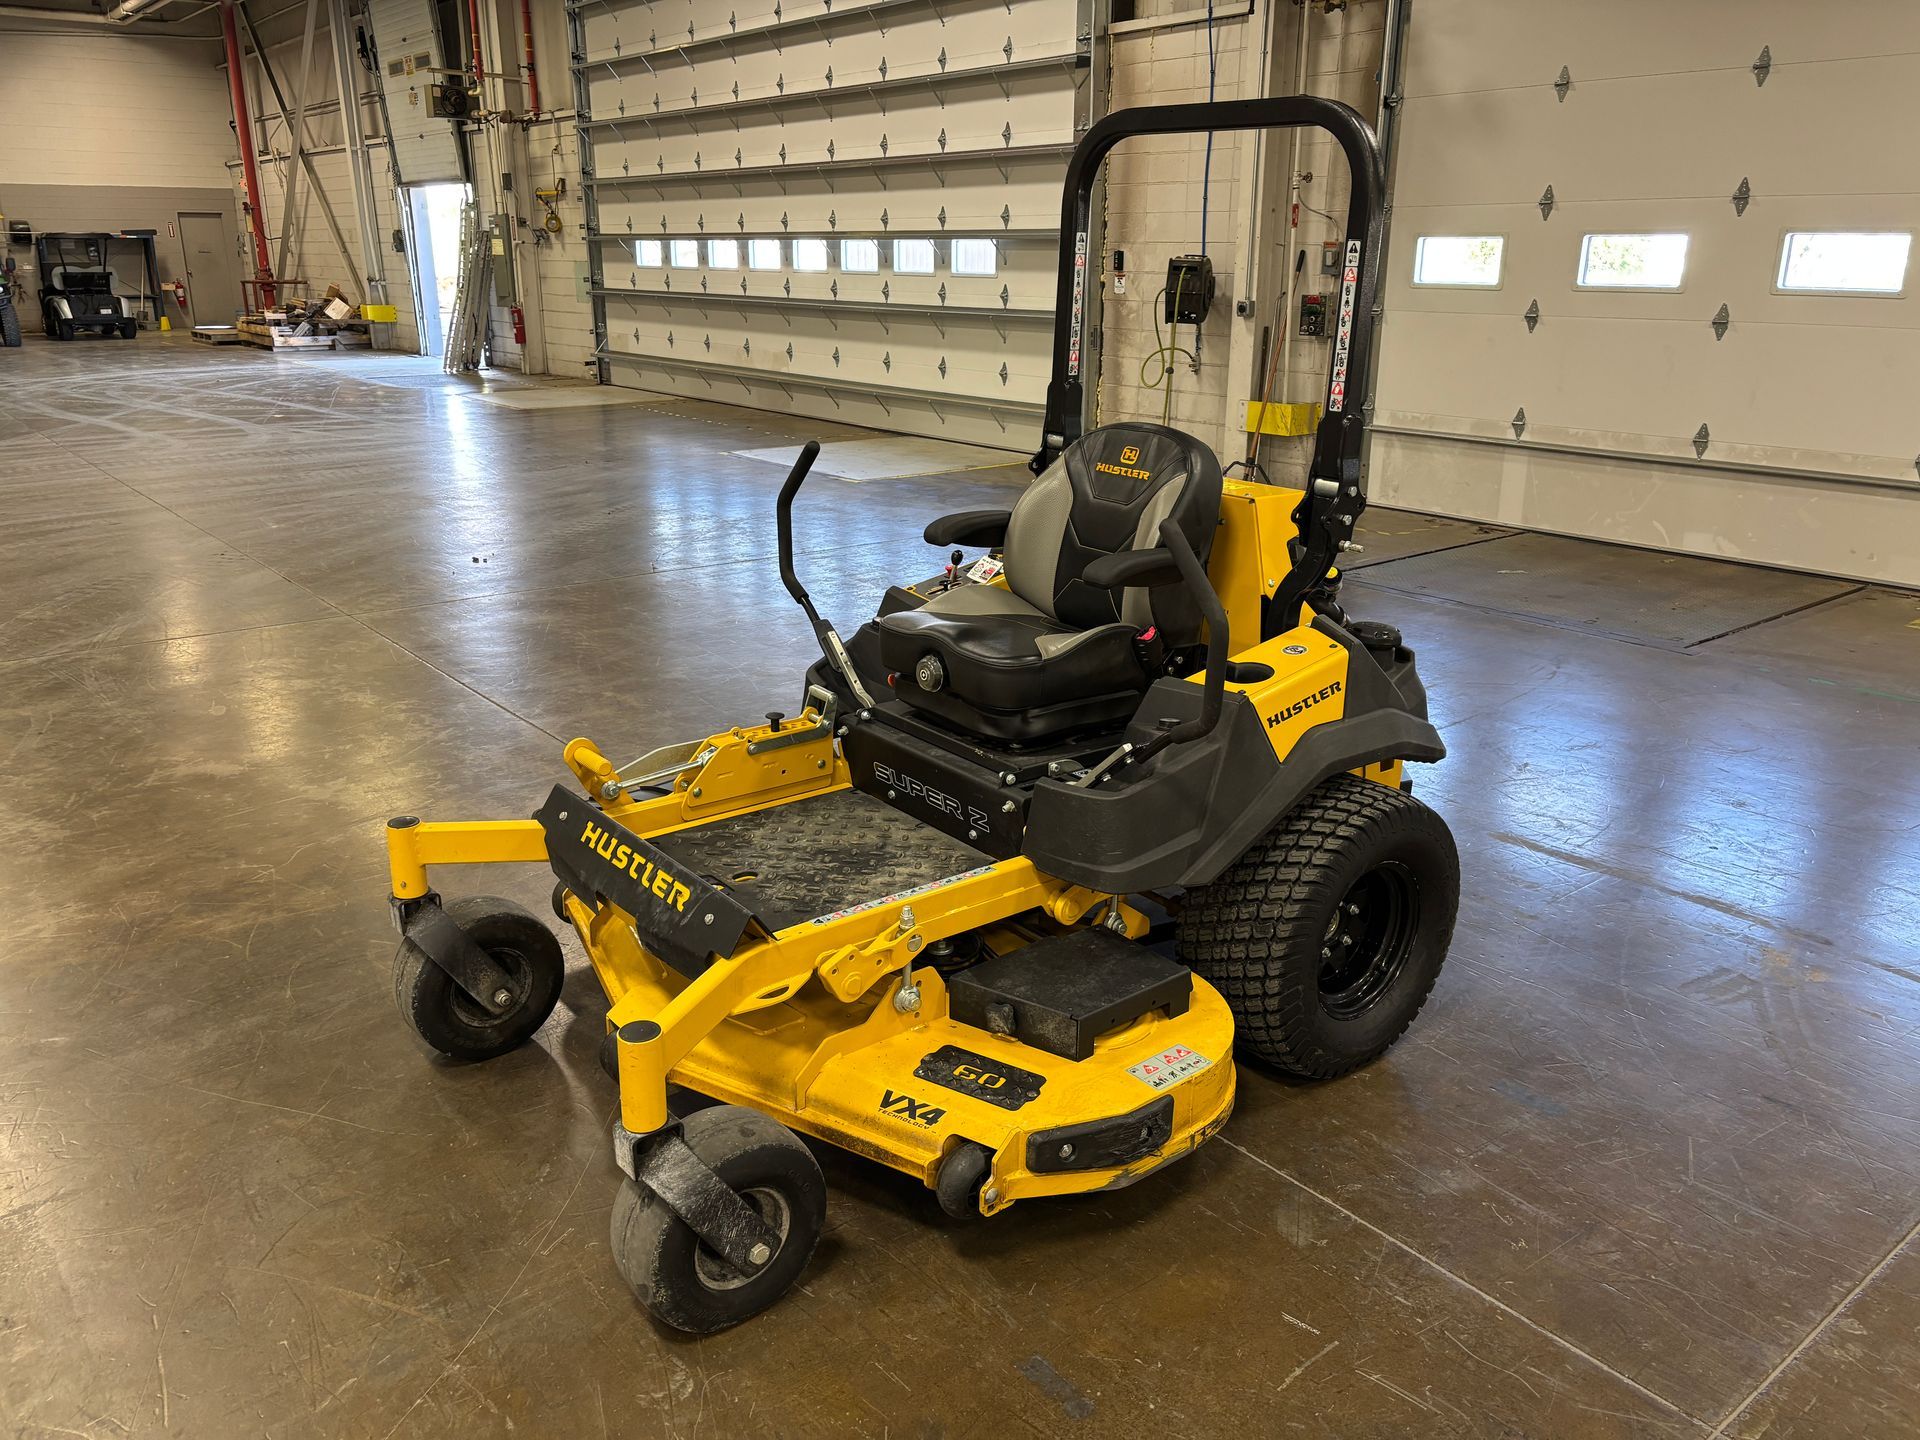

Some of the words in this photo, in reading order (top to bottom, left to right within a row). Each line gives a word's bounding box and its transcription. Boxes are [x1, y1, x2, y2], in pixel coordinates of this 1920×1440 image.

[1096, 462, 1150, 481] HUSTLER
[1266, 681, 1342, 729] HUSTLER
[873, 761, 964, 821] SUPER
[968, 805, 990, 833] Z
[580, 820, 692, 912] HUSTLER
[953, 1064, 1007, 1089] 60
[878, 1108, 930, 1130] TECHNOLOGY
[880, 1089, 947, 1126] VX4
